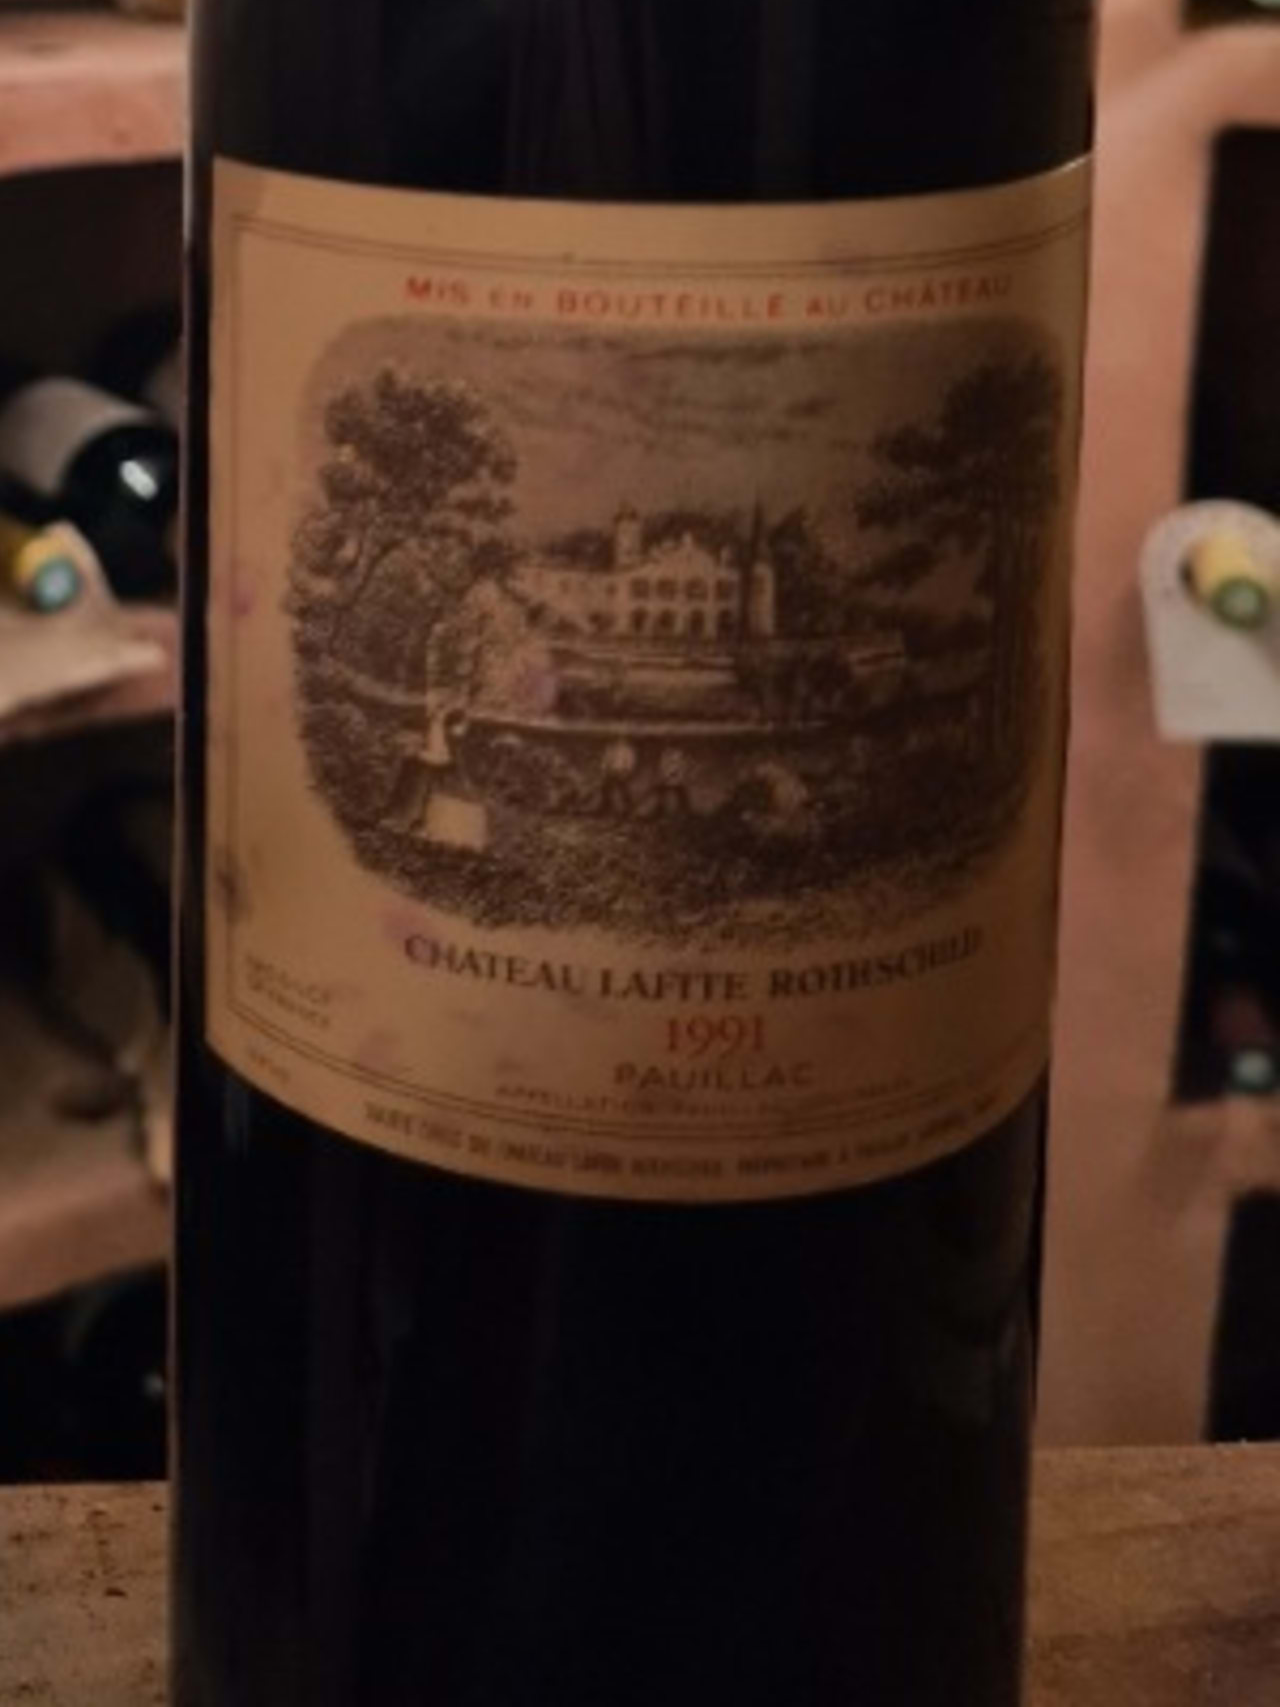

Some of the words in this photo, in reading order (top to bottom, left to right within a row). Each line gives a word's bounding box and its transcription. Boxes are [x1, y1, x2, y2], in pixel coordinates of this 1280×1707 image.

[406, 276, 469, 304] MIS
[489, 287, 533, 308] EN
[557, 289, 782, 318] BOUTEILLE
[806, 297, 850, 318] AU
[600, 967, 745, 1002] LAFITE
[770, 926, 984, 997] ROTHSCHILD
[666, 1016, 764, 1057] 1991
[614, 1063, 814, 1091] PAUILLAC
